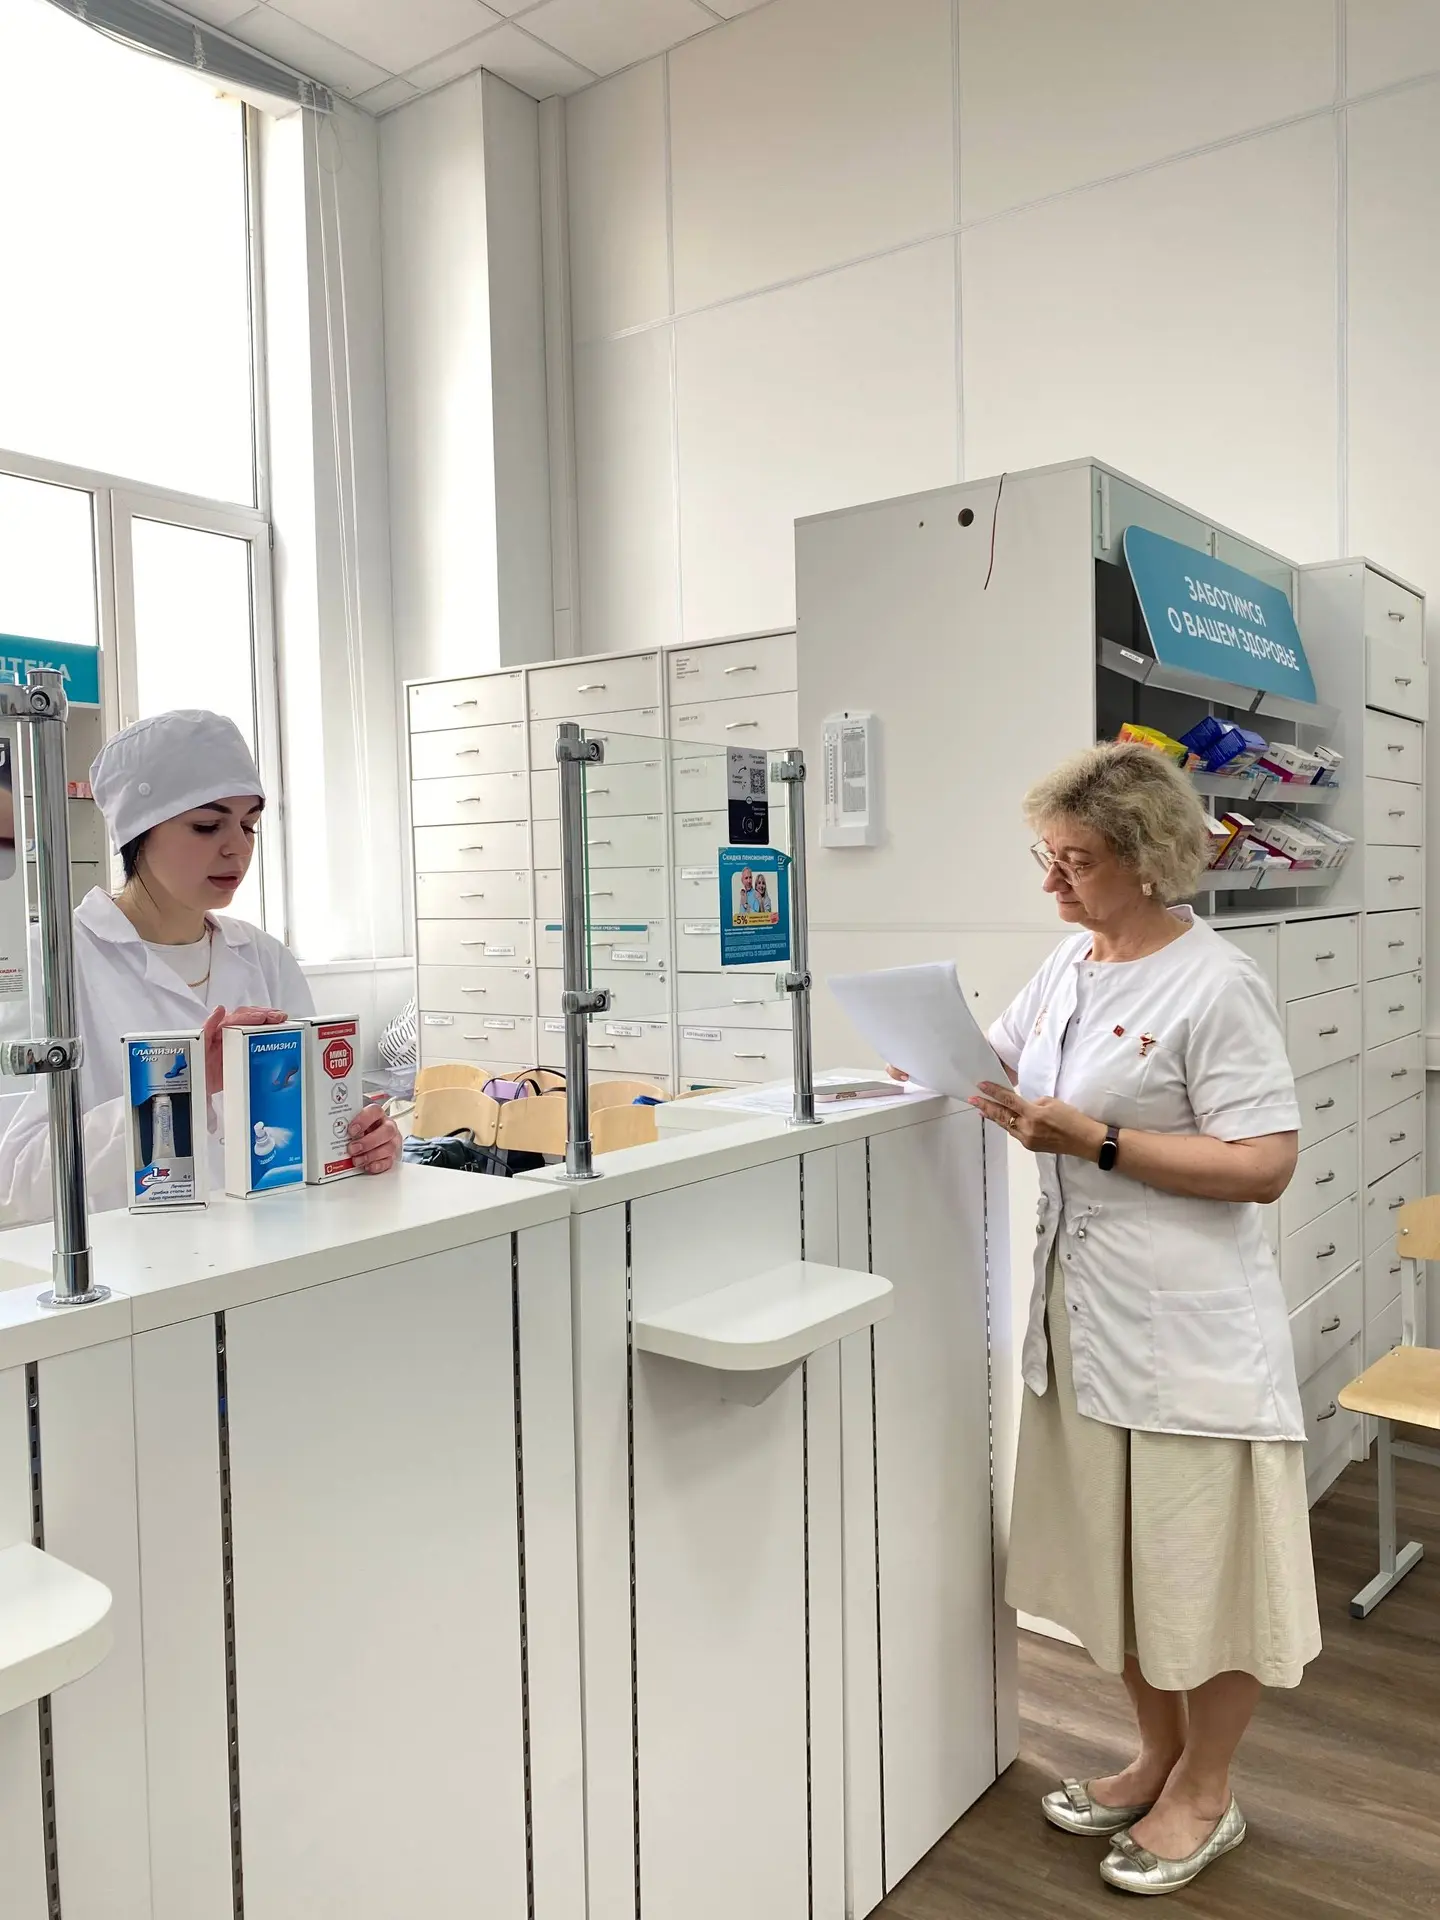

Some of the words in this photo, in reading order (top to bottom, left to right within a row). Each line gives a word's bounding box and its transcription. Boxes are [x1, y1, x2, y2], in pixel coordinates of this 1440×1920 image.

[1184, 576, 1267, 627] ЗАБОТИМСЯ
[1167, 607, 1182, 634] О
[1183, 612, 1241, 649] ВАШЕМ
[1238, 628, 1300, 672] ЗДОРОВЬЕ
[722, 853, 742, 862] Скидка
[134, 1047, 185, 1056] ЛАМИЗИЛ
[254, 1041, 298, 1053] ЛАМИЗИЛ
[329, 1058, 348, 1069] СТОП
